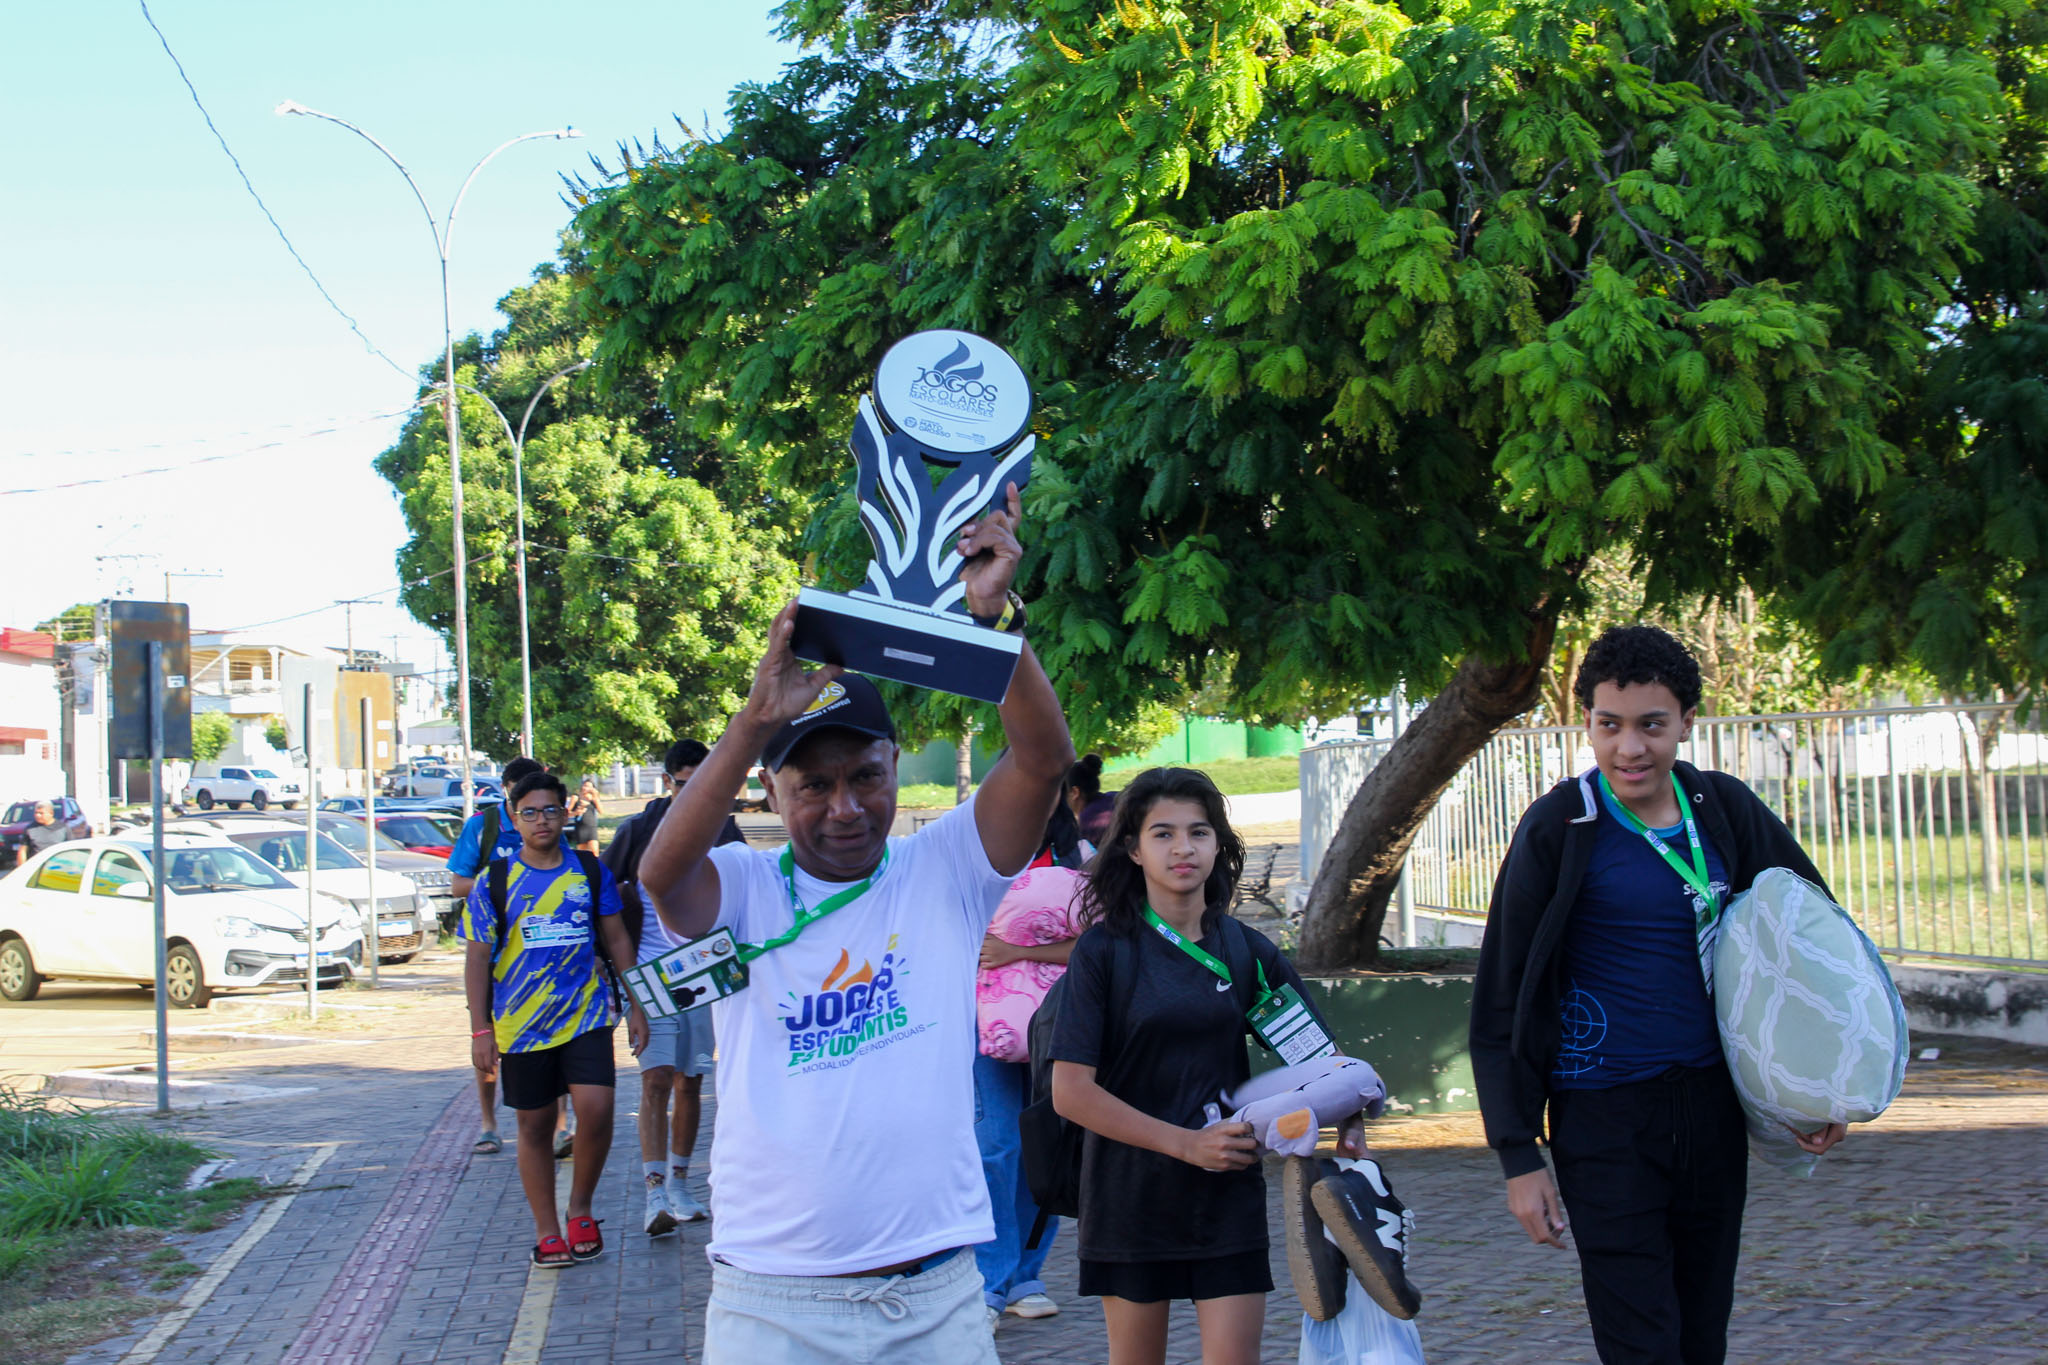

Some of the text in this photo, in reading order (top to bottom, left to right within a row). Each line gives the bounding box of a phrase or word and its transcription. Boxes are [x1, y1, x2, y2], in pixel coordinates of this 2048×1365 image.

[910, 383, 995, 412] ESCOLARES
[912, 366, 998, 402] JOGOS
[918, 425, 951, 438] GROSSO
[919, 420, 943, 431] MATO
[887, 989, 900, 1010] E
[787, 1006, 908, 1068] ESTUDANTIS
[802, 1045, 869, 1074] MODALIDAES
